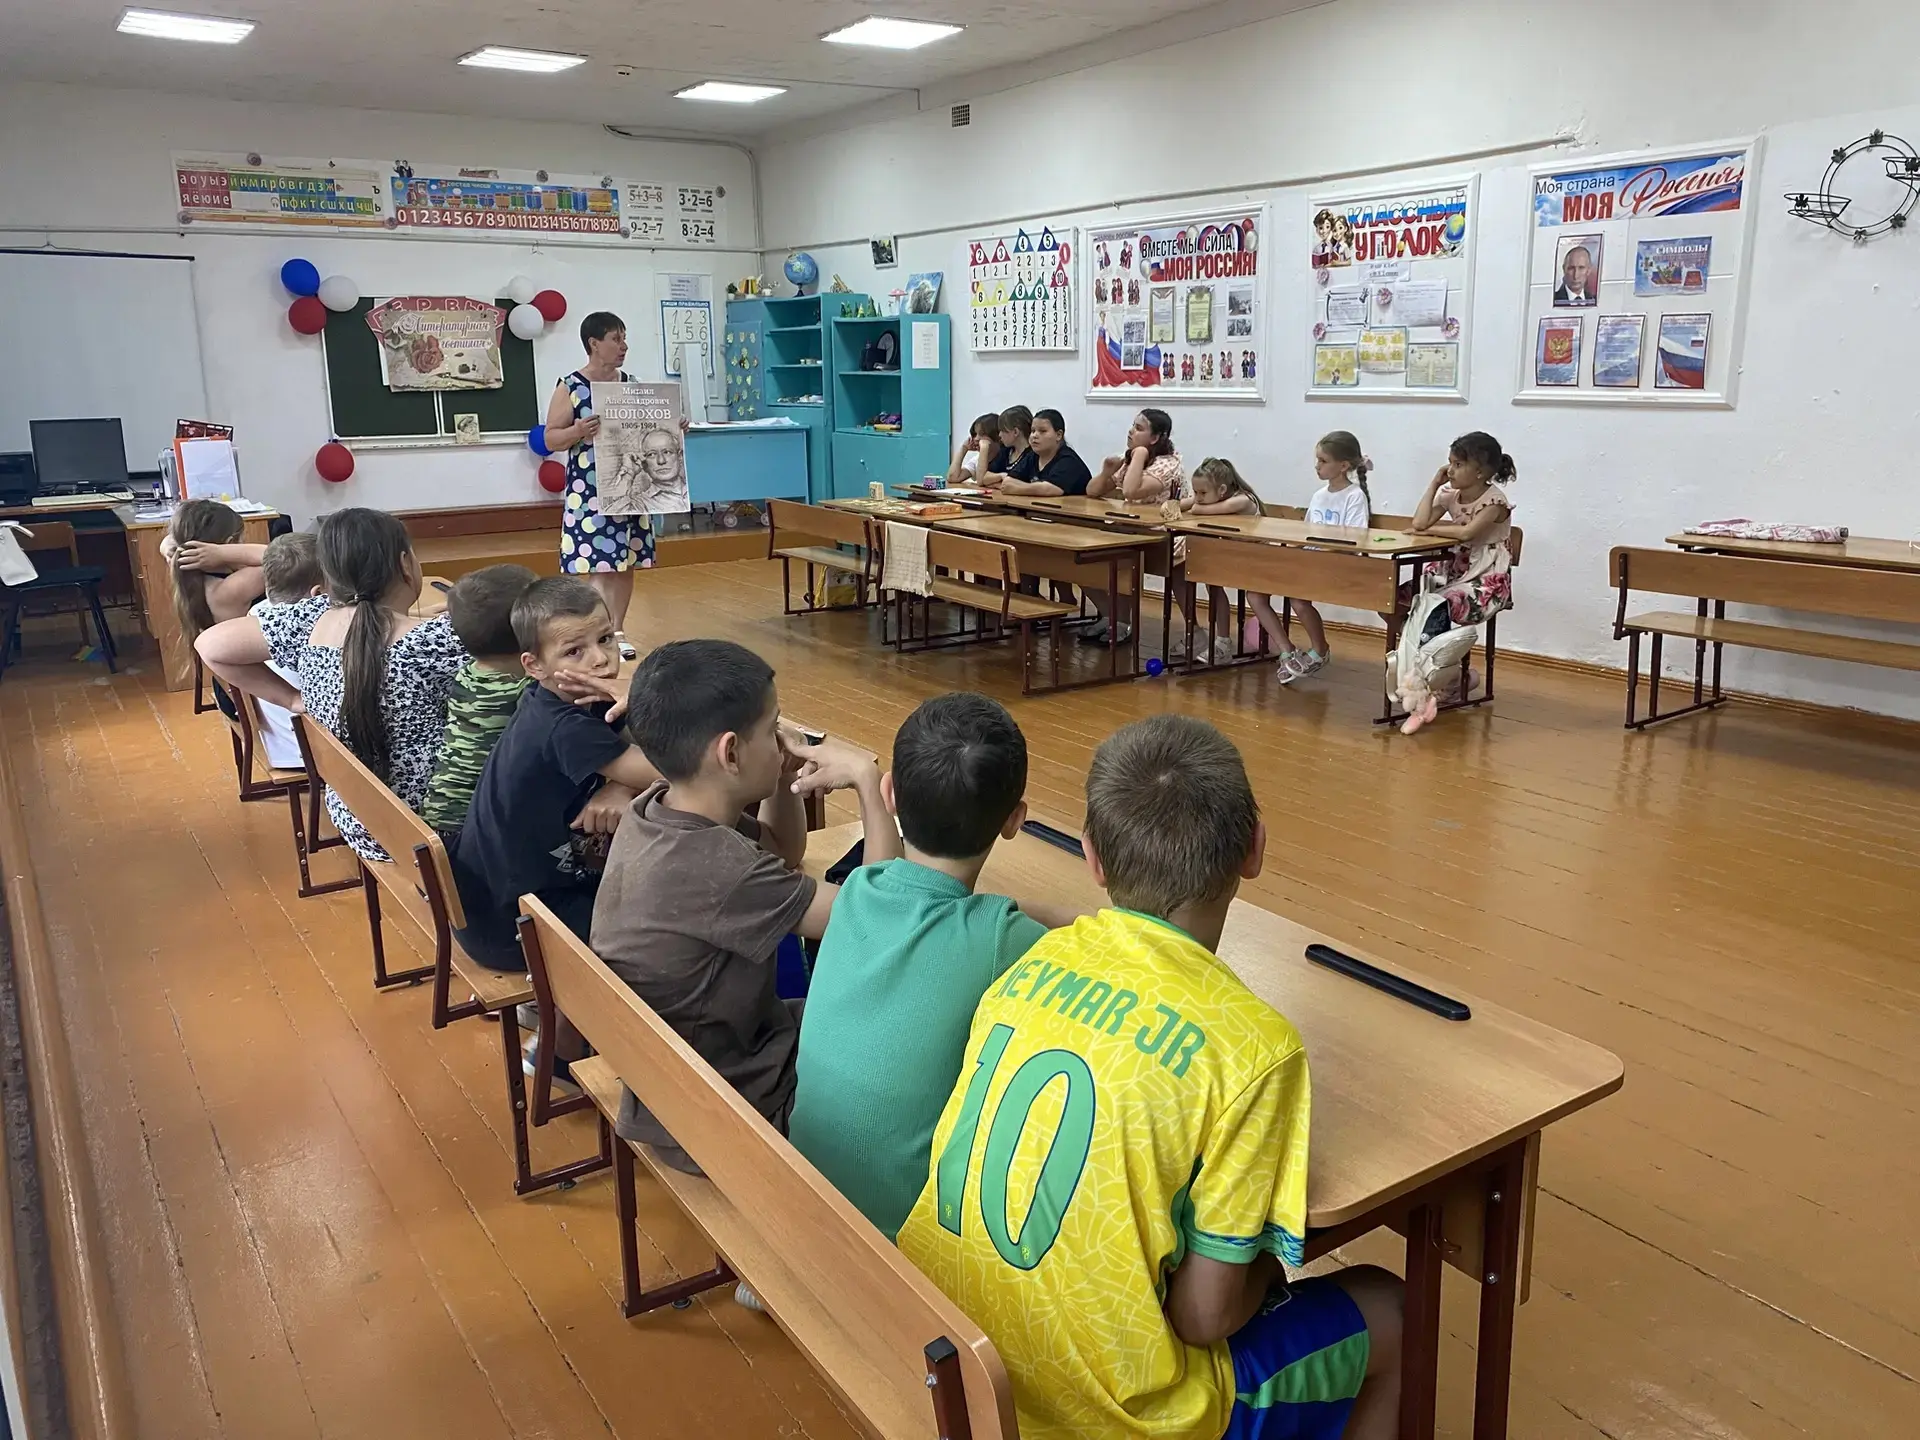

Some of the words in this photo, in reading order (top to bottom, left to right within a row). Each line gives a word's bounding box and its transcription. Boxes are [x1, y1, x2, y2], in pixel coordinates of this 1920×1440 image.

[1535, 179, 1563, 195] Моя
[1566, 175, 1615, 193] страна
[1348, 189, 1467, 230] КЛАССНЫЙ
[1563, 192, 1614, 223] МОЯ
[397, 210, 407, 223] 0
[410, 210, 417, 223] 1
[420, 210, 430, 223] 2
[432, 211, 440, 224] 3
[442, 211, 452, 224] 4
[454, 212, 462, 225] 5
[464, 212, 474, 226] 6
[475, 213, 484, 226] 7
[486, 213, 495, 226] 8
[497, 214, 506, 227] 9
[507, 215, 516, 228] 10
[517, 215, 527, 228] 11
[528, 216, 539, 228] 12
[539, 216, 549, 229] 13
[549, 216, 559, 229] 14
[559, 217, 569, 229] 15
[569, 217, 580, 230] 16
[580, 218, 590, 230] 17
[590, 218, 600, 231] 18
[600, 219, 609, 231] 19
[610, 220, 619, 231] 20
[1142, 239, 1178, 258] ВМЕСТЕ
[1181, 237, 1200, 254] МЫ
[1354, 224, 1448, 262] УГОЛОК
[1656, 244, 1708, 254] СИМВОЛЫ
[1164, 257, 1193, 281] МОЯ
[1196, 251, 1257, 279] РОССИЯ!
[672, 310, 678, 324] 1
[684, 310, 692, 324] 2
[700, 310, 707, 325] 3
[672, 326, 680, 340] 4
[686, 326, 694, 340] 5
[700, 326, 707, 341] 6
[701, 342, 708, 357] 9
[673, 358, 680, 372] 0
[622, 387, 655, 395] Михаил
[605, 397, 670, 406] Александрович
[605, 409, 672, 420] ШОЛОХОВ
[1134, 1003, 1206, 1079] JR
[937, 1023, 1096, 1272] 10
